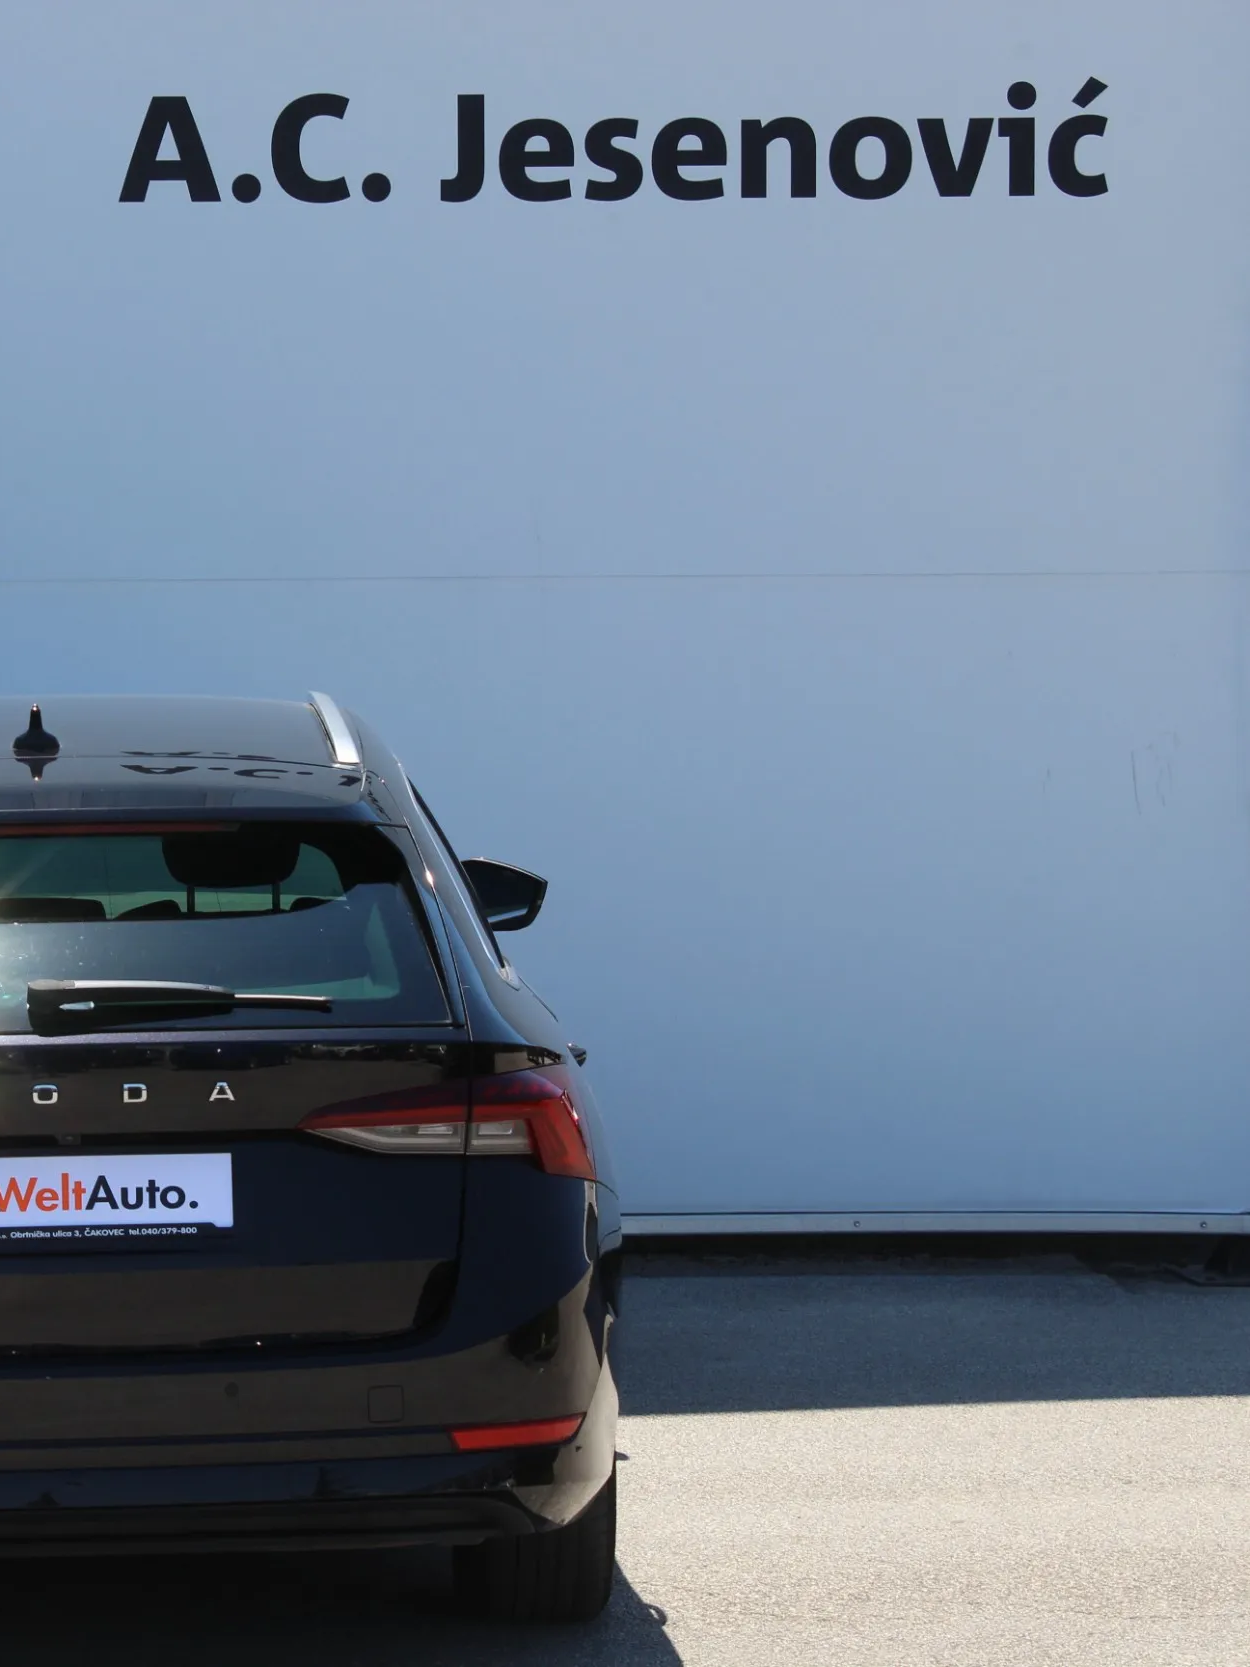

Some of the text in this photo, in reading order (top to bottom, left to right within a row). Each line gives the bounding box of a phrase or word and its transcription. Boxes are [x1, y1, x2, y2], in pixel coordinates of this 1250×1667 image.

[118, 76, 1110, 204] A.C. Jesenović
[10, 1230, 51, 1239] Obrtnička
[52, 1229, 72, 1238] ulica
[73, 1229, 82, 1238] 3,
[84, 1227, 125, 1237] ČAKOVEC
[128, 1226, 198, 1236] tel.040/379-800
